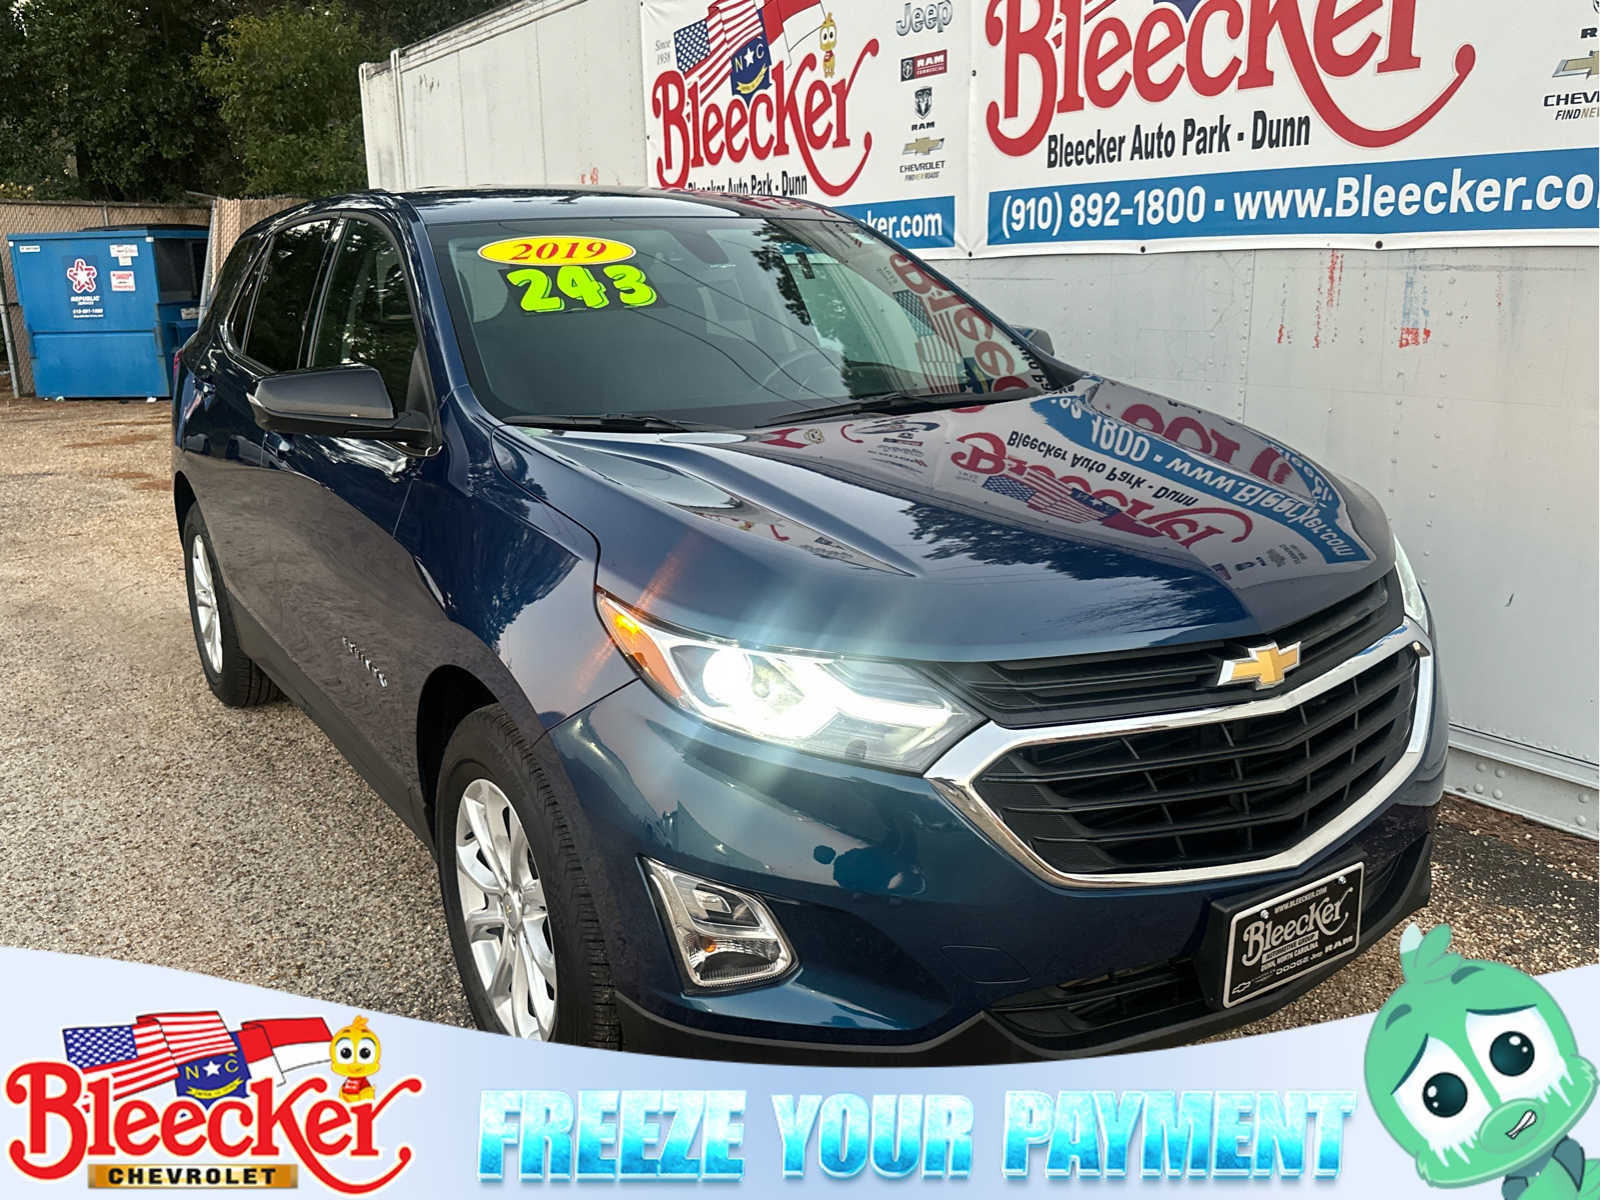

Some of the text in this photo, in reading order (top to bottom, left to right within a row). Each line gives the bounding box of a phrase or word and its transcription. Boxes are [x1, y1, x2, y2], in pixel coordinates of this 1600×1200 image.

[896, 0, 952, 36] Jeep
[917, 54, 945, 67] RAM
[985, 0, 1476, 158] Bleecker
[652, 38, 879, 197] Bleecker
[911, 121, 935, 131] RAM
[1047, 110, 1311, 168] Bleecker Auto Park Dunn
[751, 173, 773, 197] Park
[781, 171, 807, 197] Dunn
[899, 160, 945, 173] CHEVROLET
[1002, 168, 1599, 239] (910) 892-1800 www.Bleecker.co
[509, 242, 607, 261] 2019
[507, 265, 657, 313] 243
[1242, 887, 1354, 967] Bleecker
[1276, 956, 1310, 976] DODGE
[1324, 935, 1354, 954] RAM
